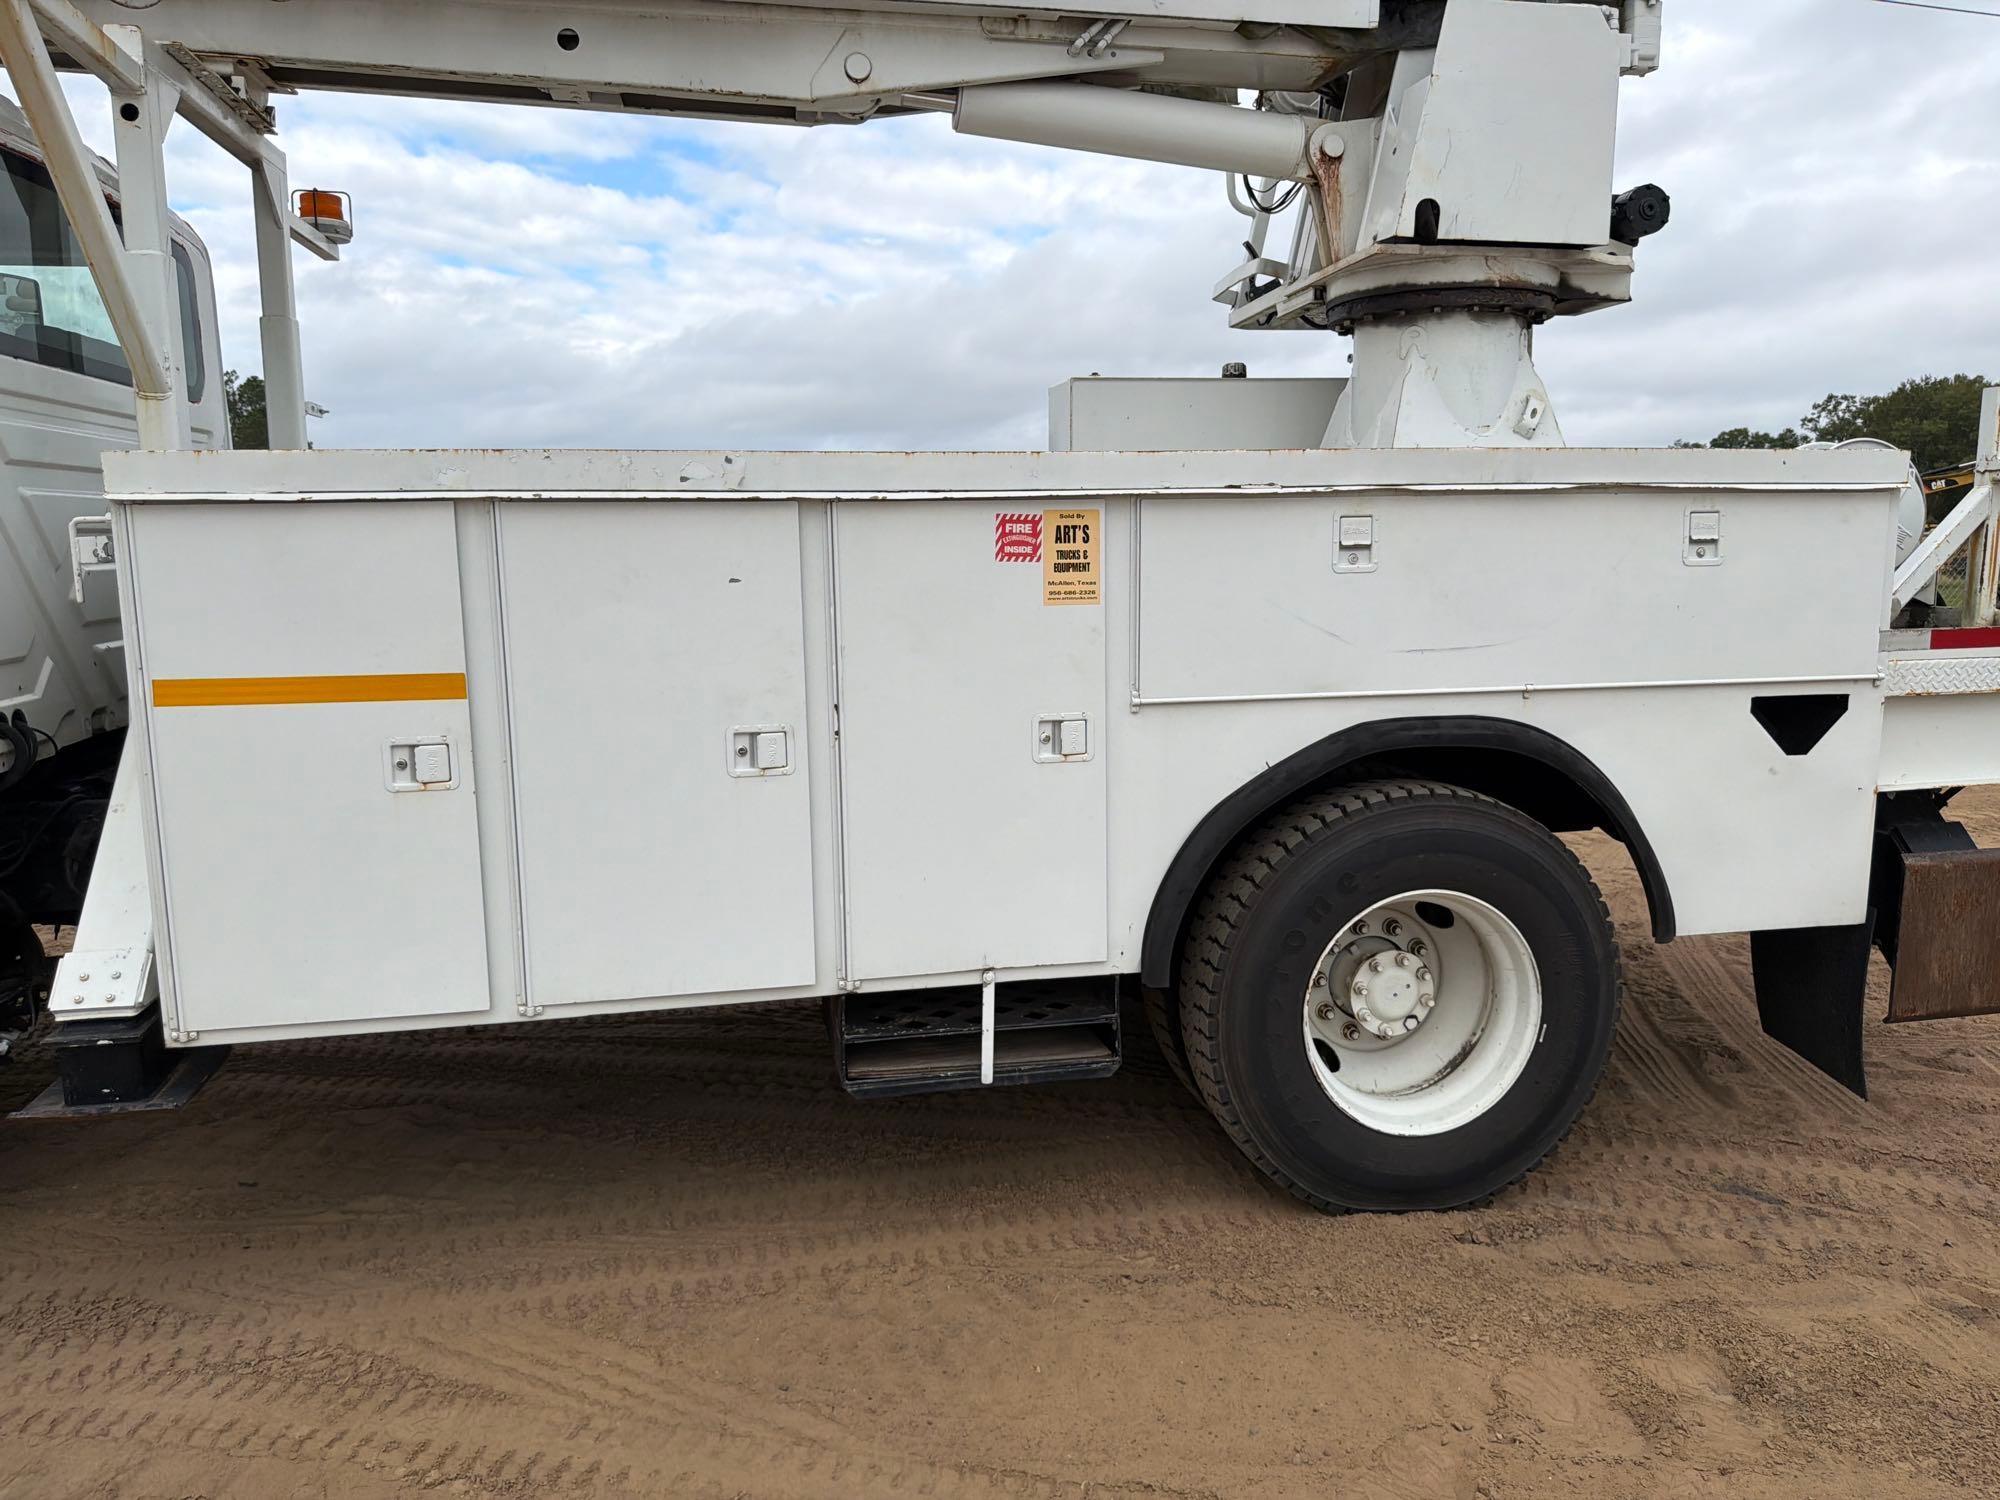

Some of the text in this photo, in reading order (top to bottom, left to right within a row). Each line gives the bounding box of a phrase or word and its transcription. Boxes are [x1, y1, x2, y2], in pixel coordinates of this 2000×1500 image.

[1931, 479, 1946, 489] CAT
[1005, 523, 1033, 534] FIRE
[1054, 524, 1090, 544] ART'S
[1004, 545, 1033, 554] INSIDE
[1056, 549, 1089, 560] TRUCKS &
[1053, 562, 1091, 573] EQUIPMENT
